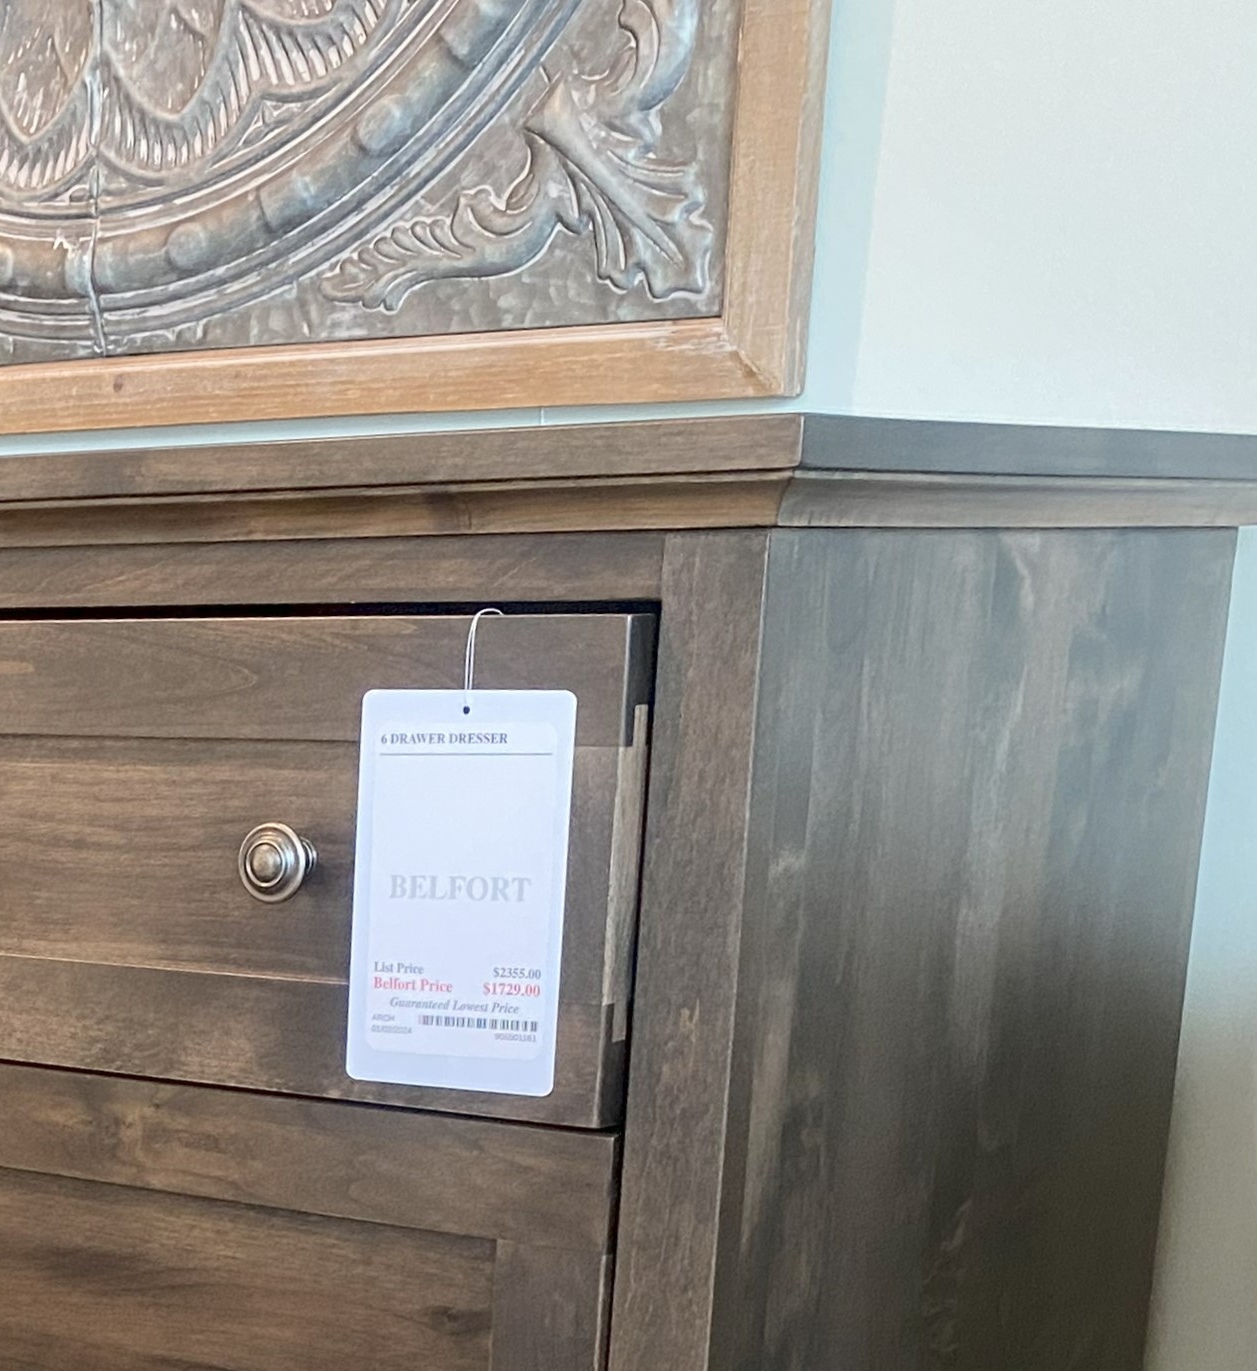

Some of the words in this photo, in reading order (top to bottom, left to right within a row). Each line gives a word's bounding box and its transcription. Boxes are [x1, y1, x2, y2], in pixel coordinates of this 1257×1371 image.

[381, 734, 388, 744] 6
[390, 733, 446, 744] DRAWER
[448, 733, 509, 744] DRESSER
[389, 874, 533, 902] BELFORT
[373, 961, 394, 973] List
[397, 962, 425, 975] Price
[493, 967, 542, 980] $2355.00
[373, 976, 417, 991] Belfort
[420, 979, 454, 993] Price
[483, 982, 541, 998] $1729.00
[389, 997, 451, 1010] Guaranteed
[452, 1000, 489, 1013] Lowest
[492, 1001, 520, 1014] Price
